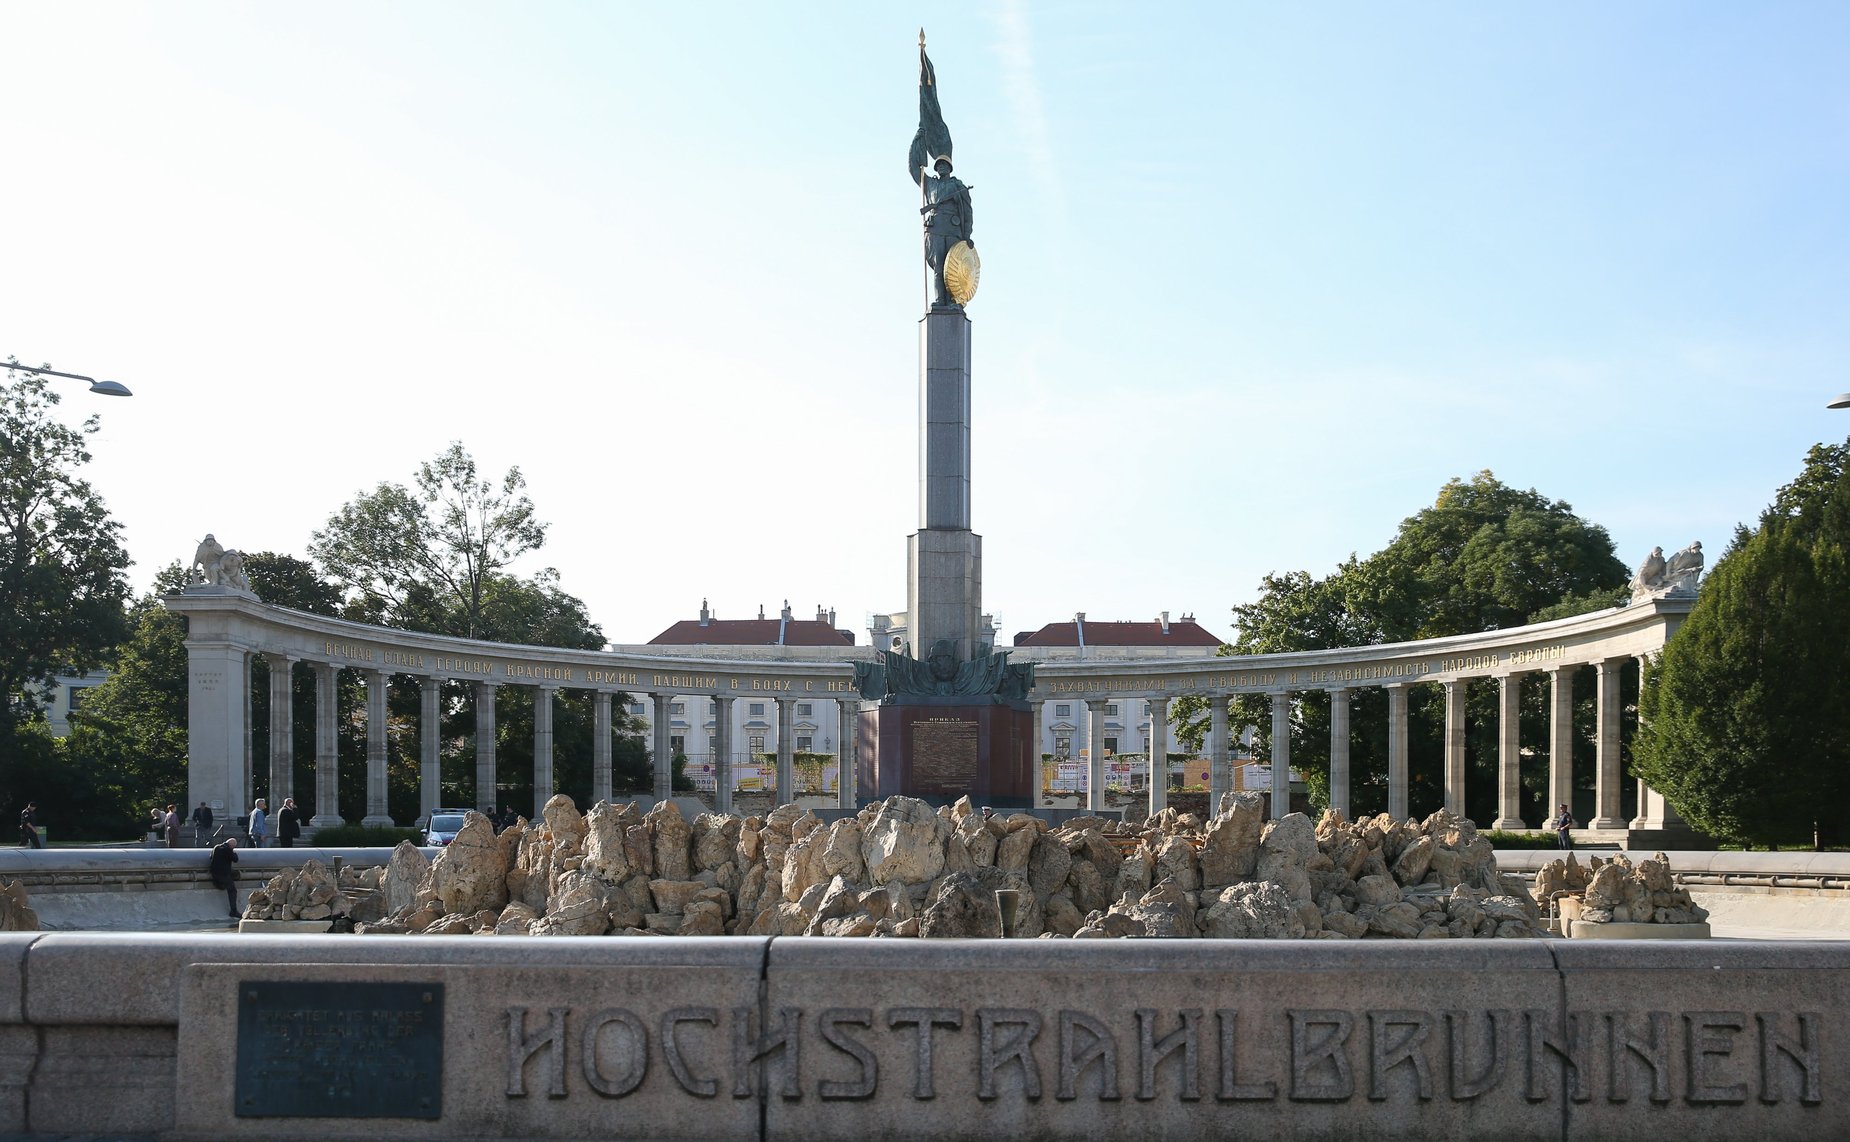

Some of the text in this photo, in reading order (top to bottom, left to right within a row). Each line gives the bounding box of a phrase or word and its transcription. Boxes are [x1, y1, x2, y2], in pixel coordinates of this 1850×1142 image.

[325, 642, 372, 661] ВЕЧНАЯ
[384, 651, 424, 668] СЛАВА
[436, 657, 493, 675] ГЕРОЯМ
[506, 664, 573, 681] КРАСНОЙ
[653, 675, 717, 689] ПАВШИМ
[731, 678, 739, 689] В
[752, 680, 792, 691] БОЯХ
[805, 680, 814, 691] С
[1050, 680, 1166, 693] ЗАХВАТЧИКАМИ
[1179, 679, 1196, 689] ЗА
[1209, 674, 1277, 688] СВОБОДУ
[1289, 673, 1298, 684] И
[1311, 662, 1429, 683] НЕЗАВИСИМОСТЬ
[1441, 655, 1500, 672] НАРОДОВ
[505, 1005, 1824, 1106] HOCHSTRAHLBRUNNEN
